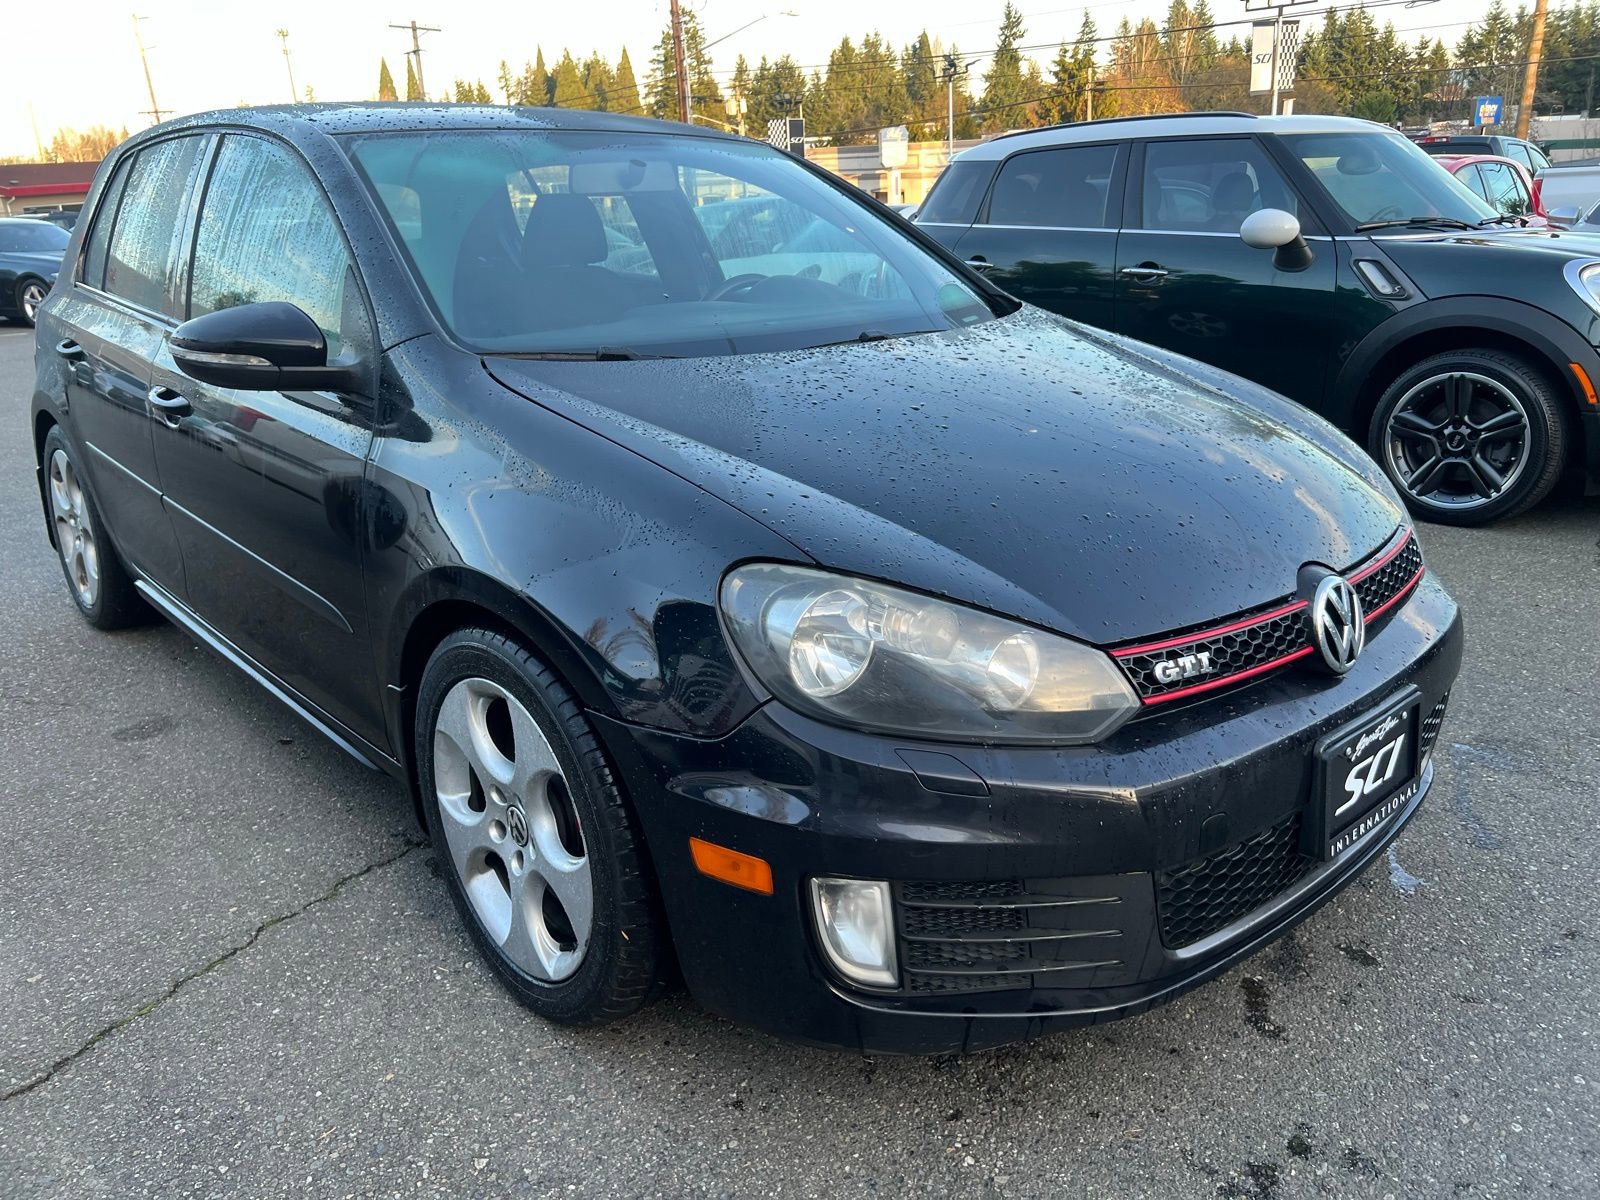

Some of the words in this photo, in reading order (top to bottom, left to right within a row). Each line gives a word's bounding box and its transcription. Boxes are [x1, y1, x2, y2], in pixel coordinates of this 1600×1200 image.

[1252, 53, 1272, 64] SCI
[1153, 651, 1213, 684] GTI
[1334, 732, 1406, 817] SCI
[1330, 782, 1419, 857] INTERNATIONAL
